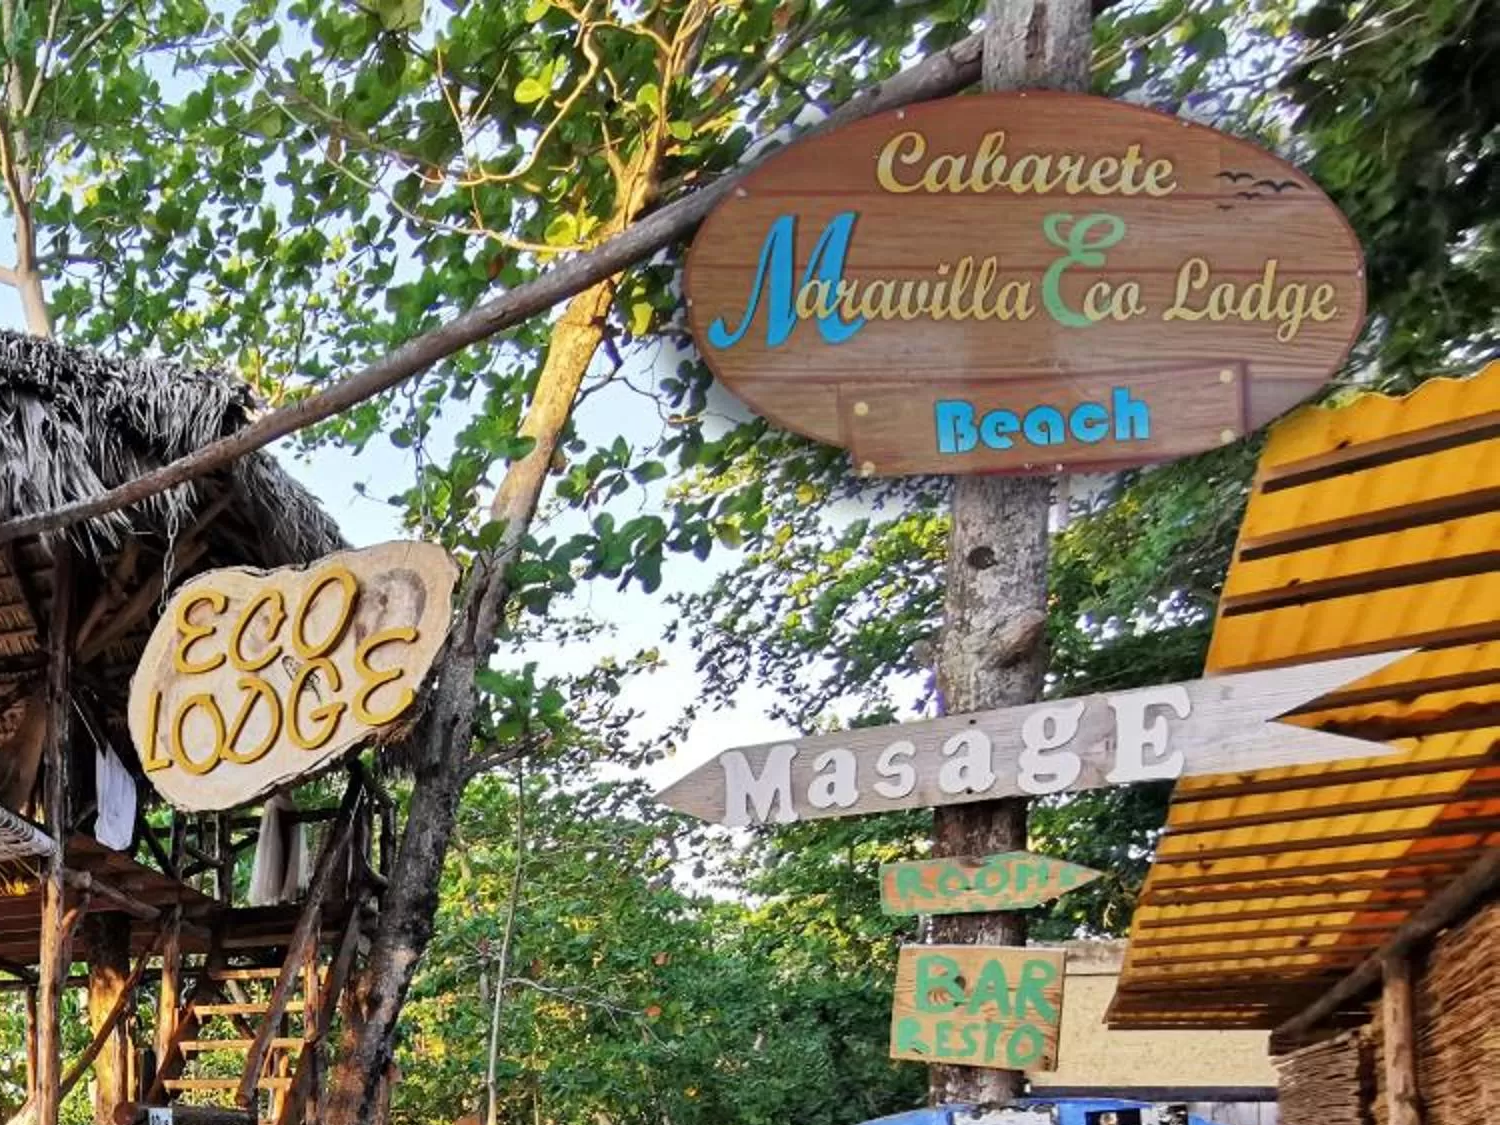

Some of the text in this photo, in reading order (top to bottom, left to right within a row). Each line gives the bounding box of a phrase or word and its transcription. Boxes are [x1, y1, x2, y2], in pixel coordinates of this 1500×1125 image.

[876, 131, 1177, 196] Cabarete
[707, 210, 1336, 350] Maravilla Eco Lodge
[933, 387, 1150, 454] Beach
[174, 564, 358, 674] ECO
[146, 627, 419, 776] LODGE
[915, 954, 1058, 1024] BAR
[897, 1017, 1045, 1067] RESTO
